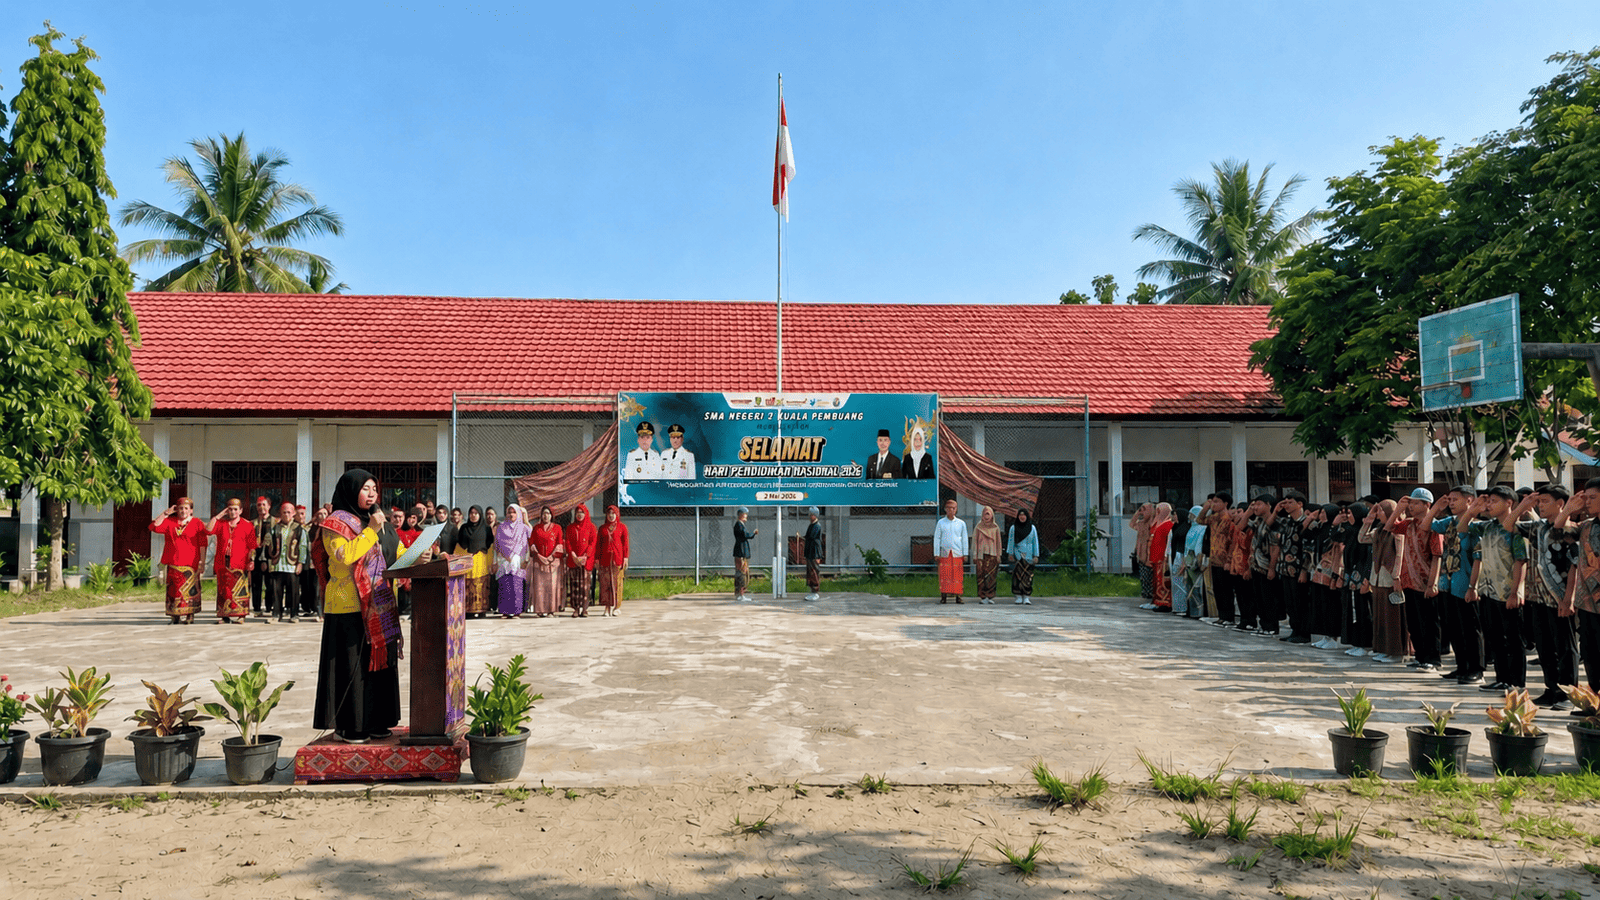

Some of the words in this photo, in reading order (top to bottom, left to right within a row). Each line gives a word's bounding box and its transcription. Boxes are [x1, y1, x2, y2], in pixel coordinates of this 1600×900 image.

[704, 411, 725, 421] SMA
[728, 411, 765, 421] NEGERI
[767, 411, 774, 421] 2
[777, 411, 808, 421] KUALA
[811, 411, 864, 421] PEMBUANG
[738, 436, 825, 462] SELAMAT
[704, 465, 729, 477] HARI
[793, 465, 839, 477] NASIONAL
